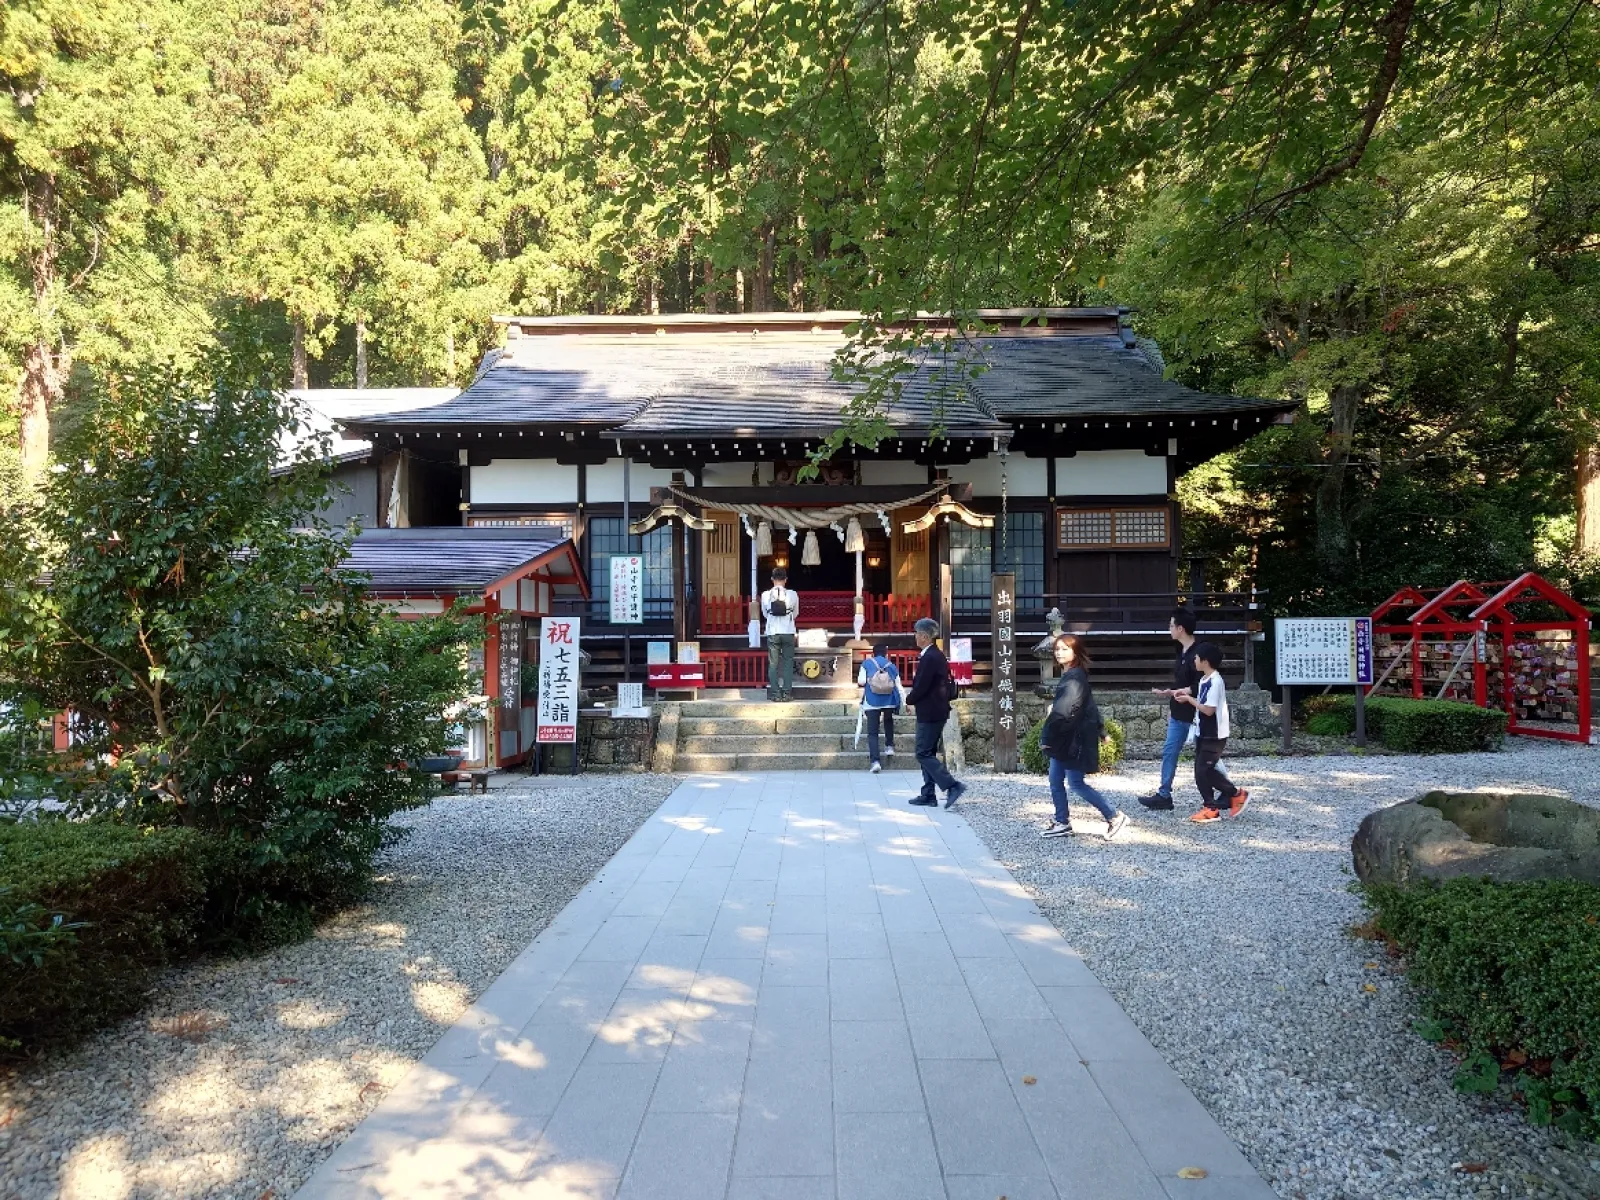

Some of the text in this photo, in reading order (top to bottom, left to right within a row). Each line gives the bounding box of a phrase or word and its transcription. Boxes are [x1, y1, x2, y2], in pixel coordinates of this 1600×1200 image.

[547, 621, 573, 645] 祝
[551, 647, 573, 723] 七五三詣
